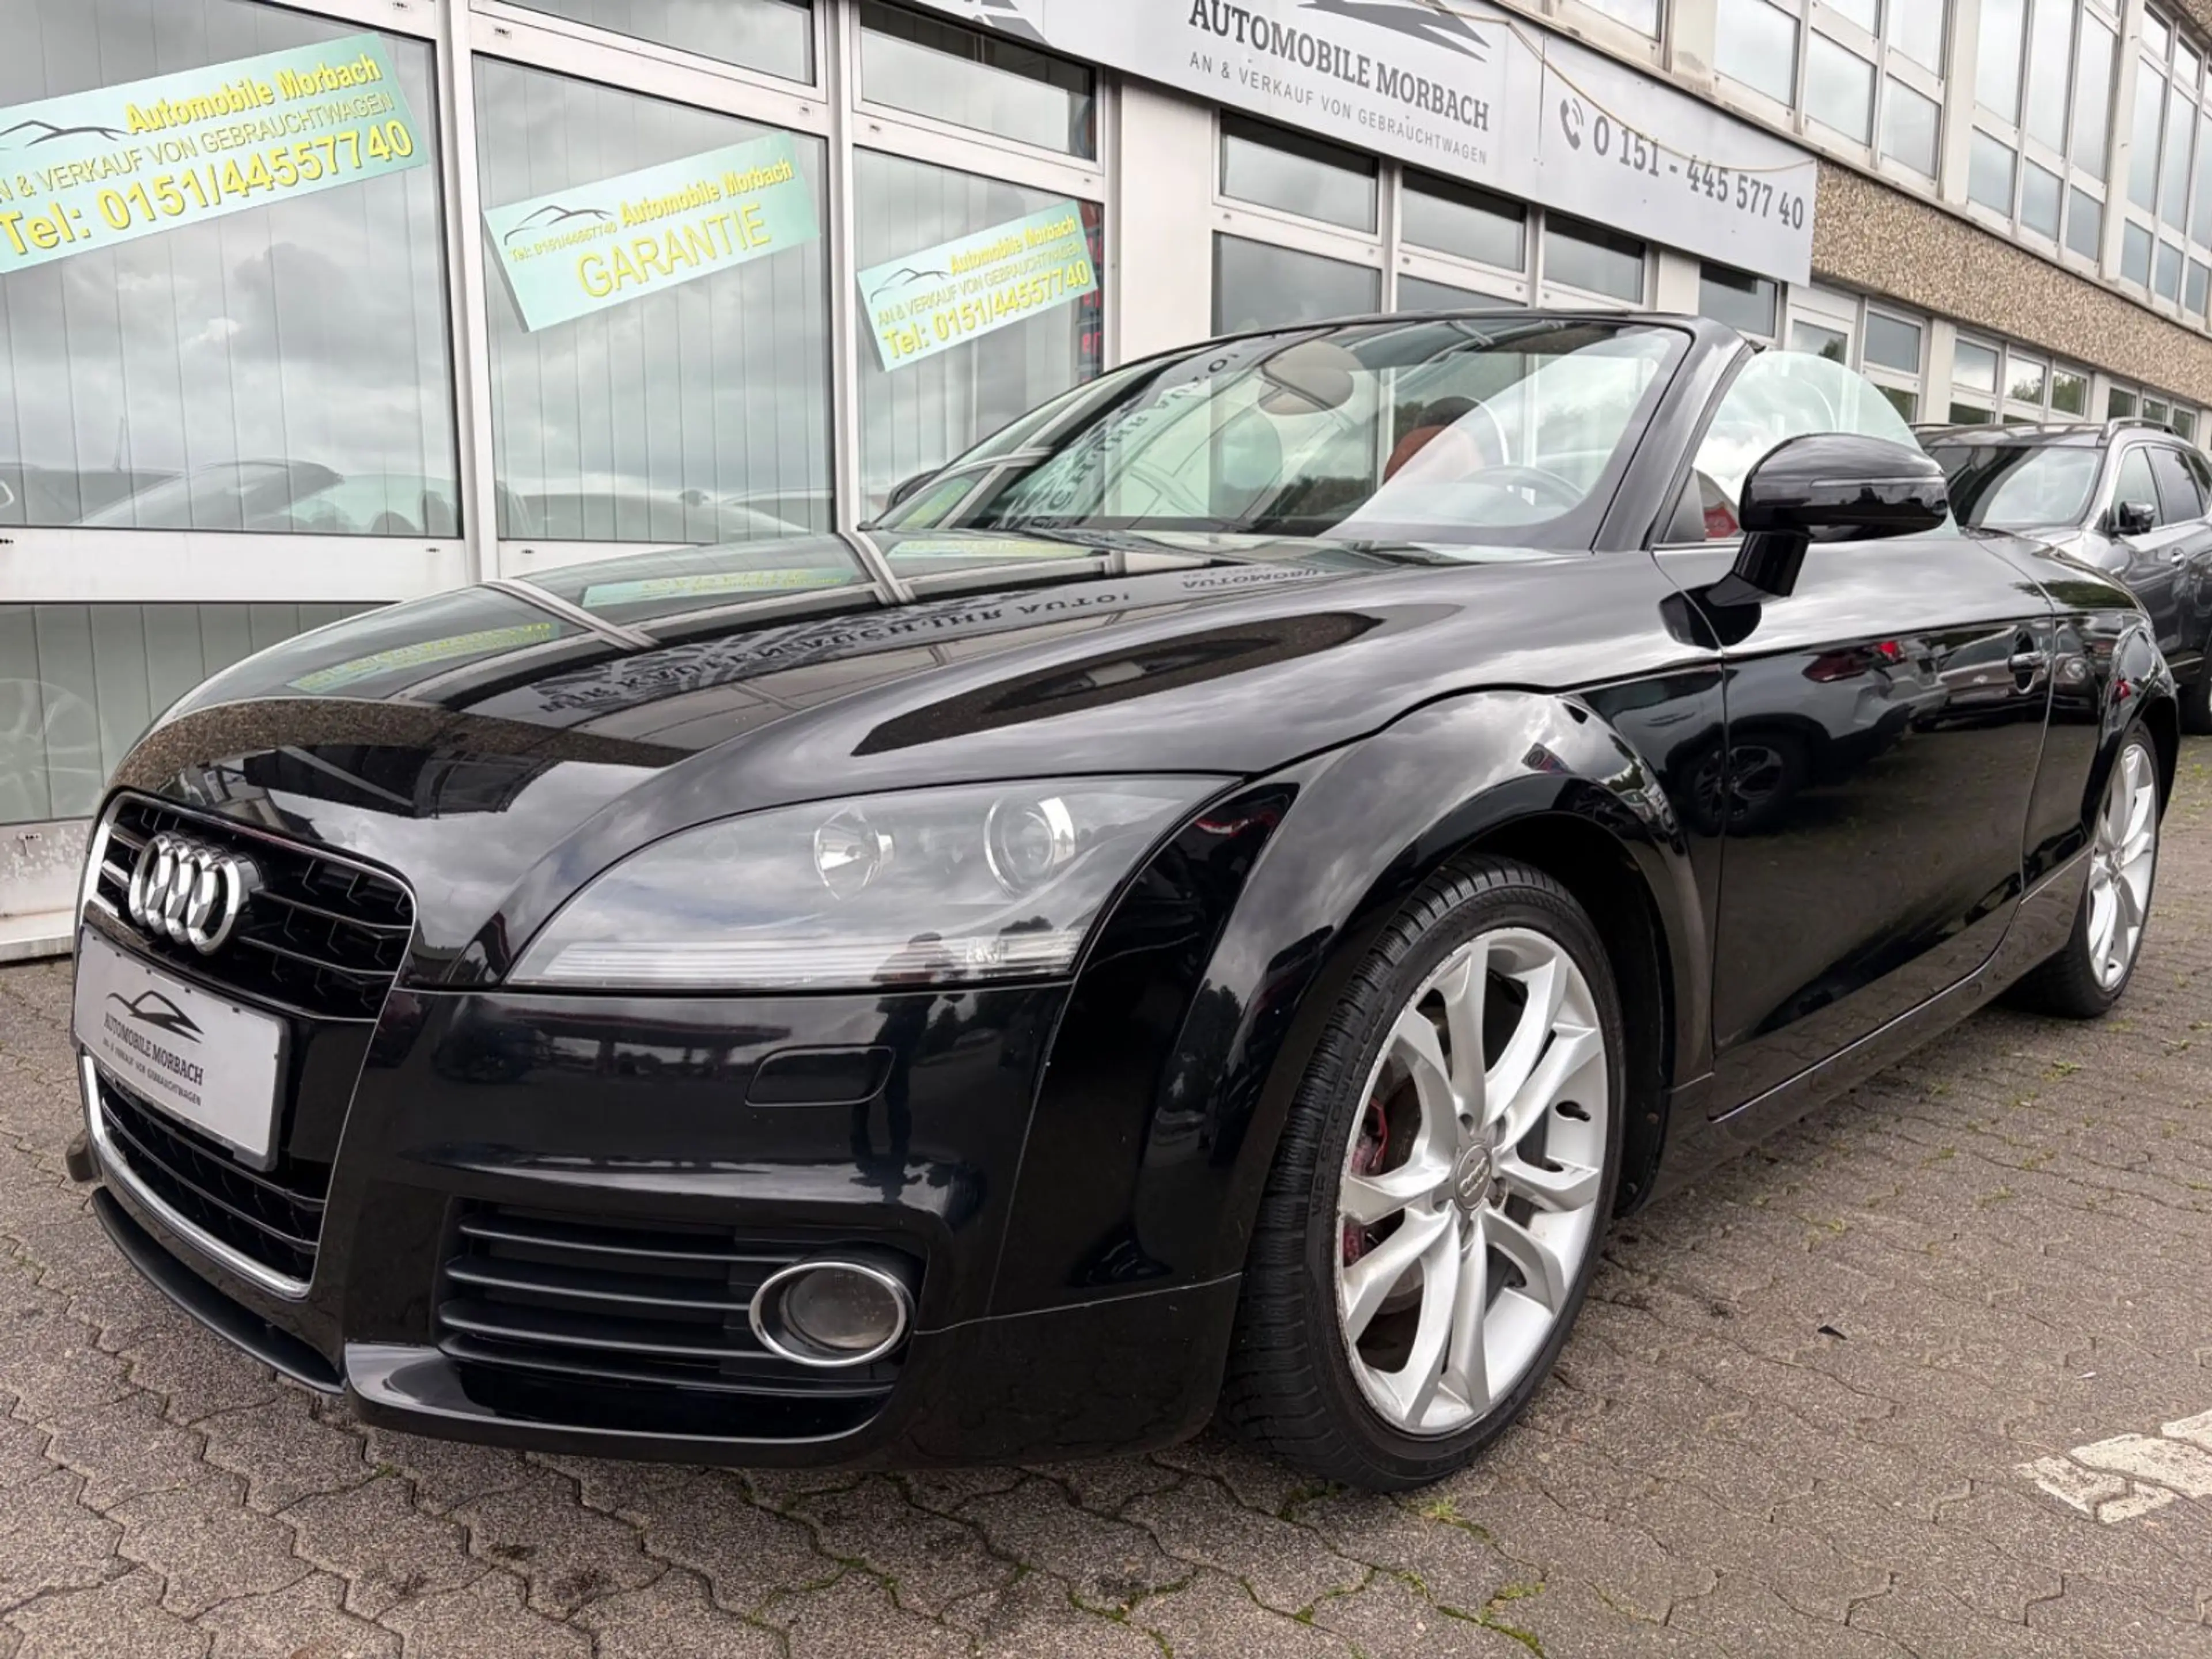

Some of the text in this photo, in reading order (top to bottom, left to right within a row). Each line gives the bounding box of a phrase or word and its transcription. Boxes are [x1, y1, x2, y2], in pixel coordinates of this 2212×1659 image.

[125, 53, 384, 135] Automobile Morbach
[1188, 0, 1490, 131] AUTOMOBILE MORBACH
[1190, 51, 1487, 166] AN & VERKAUF VON GEBRAUCHTWAGEN
[0, 119, 414, 255] Tel: 0151/44557740
[17, 175, 37, 197] &
[35, 148, 143, 192] VERKAUF
[147, 134, 199, 165] VON
[200, 91, 396, 154] GEBRAUCHTWAGEN
[620, 156, 795, 227] Automobile Morbach
[1593, 115, 1610, 156] 0
[1619, 127, 1660, 177] 151
[1686, 154, 1729, 203] 445
[1736, 172, 1774, 218] 577
[1778, 192, 1804, 230] 40
[577, 203, 772, 298] GARANTIE
[950, 214, 1077, 276] Automobile Morbach
[882, 320, 930, 359] Tel:
[933, 259, 1090, 342] 0151/44557740
[104, 1012, 151, 1058] AUTOMOBILE
[152, 1043, 204, 1086] MORBACH
